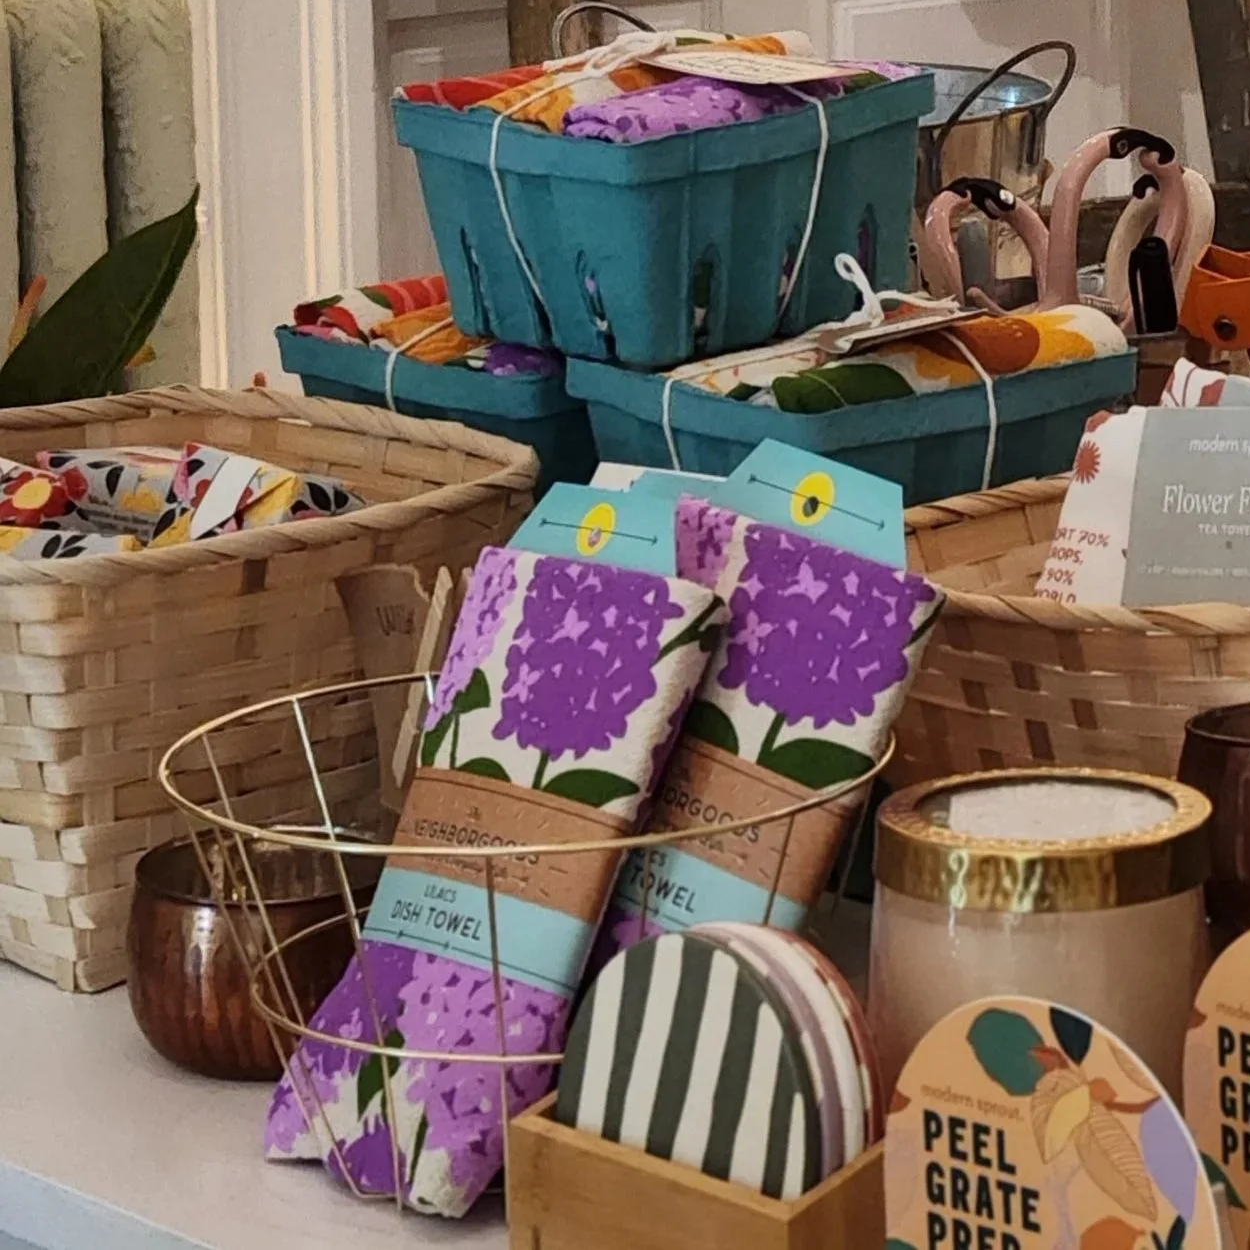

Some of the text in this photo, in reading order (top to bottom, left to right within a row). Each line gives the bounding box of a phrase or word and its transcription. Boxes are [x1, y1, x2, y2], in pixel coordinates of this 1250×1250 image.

[1162, 484, 1234, 514] Flower
[391, 900, 482, 941] DISH TOWEL
[922, 1108, 1017, 1176] PEEL
[925, 1161, 1042, 1233] GRATE
